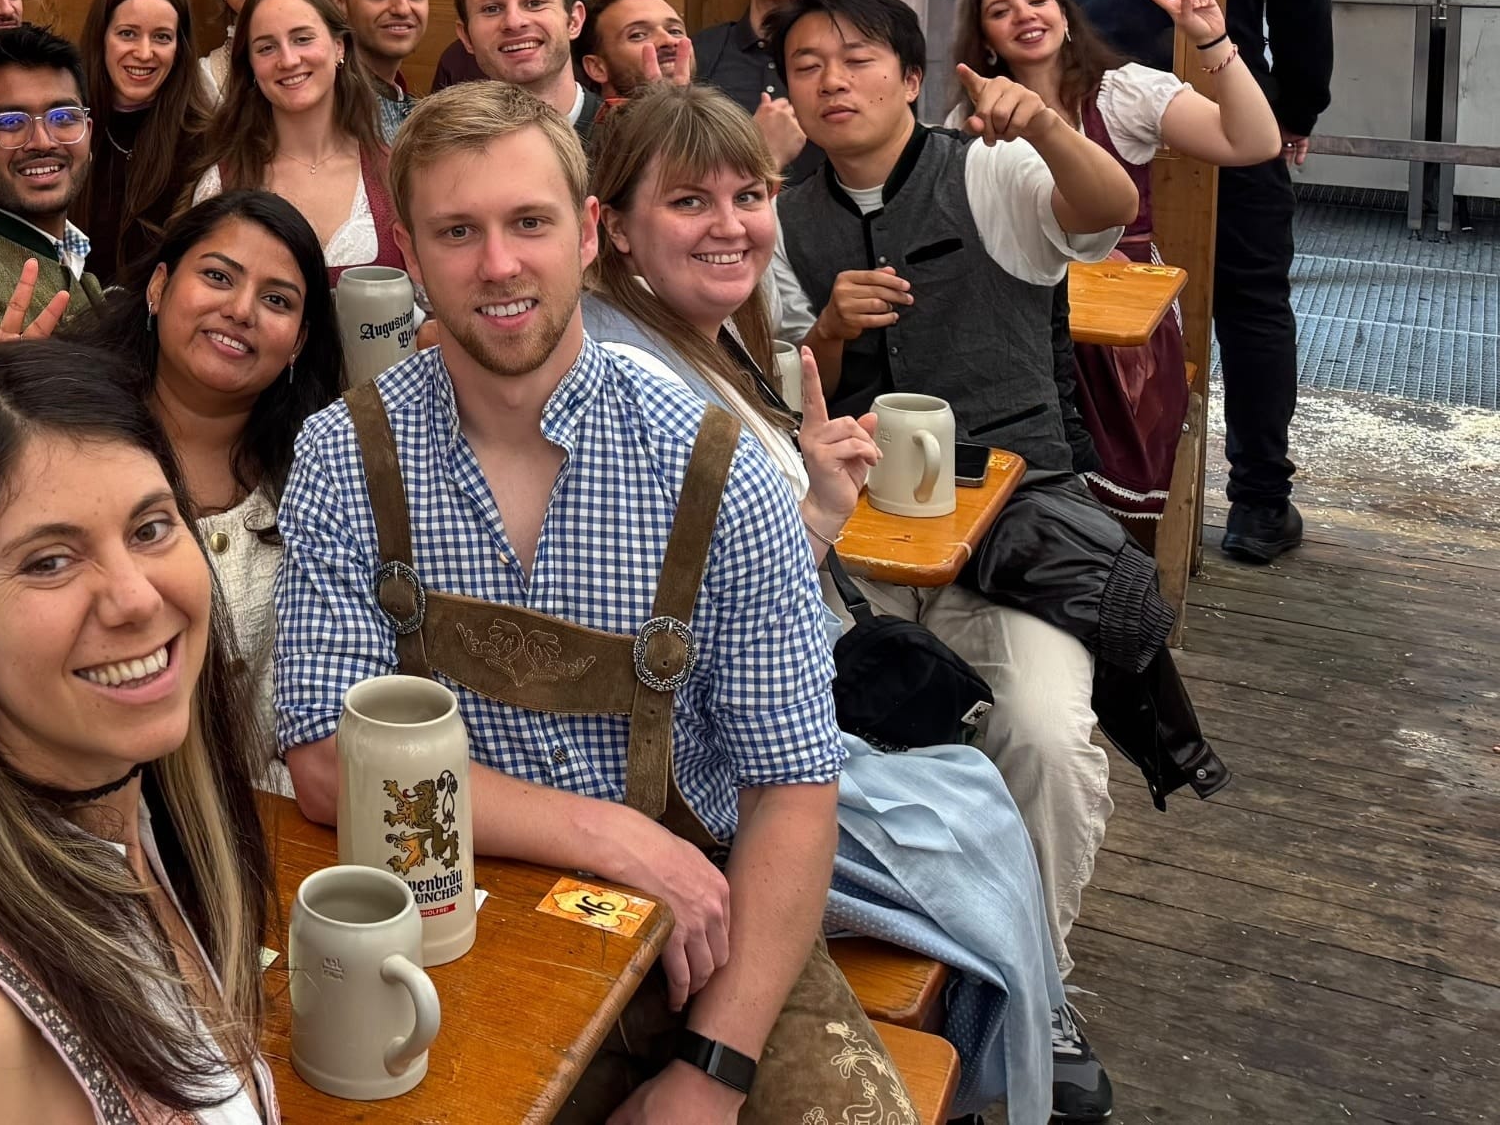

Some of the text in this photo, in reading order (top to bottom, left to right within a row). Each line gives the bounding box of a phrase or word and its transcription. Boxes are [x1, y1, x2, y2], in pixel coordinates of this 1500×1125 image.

[360, 308, 414, 340] Augustine
[415, 883, 463, 904] ÜNCHEN
[575, 895, 616, 916] 16
